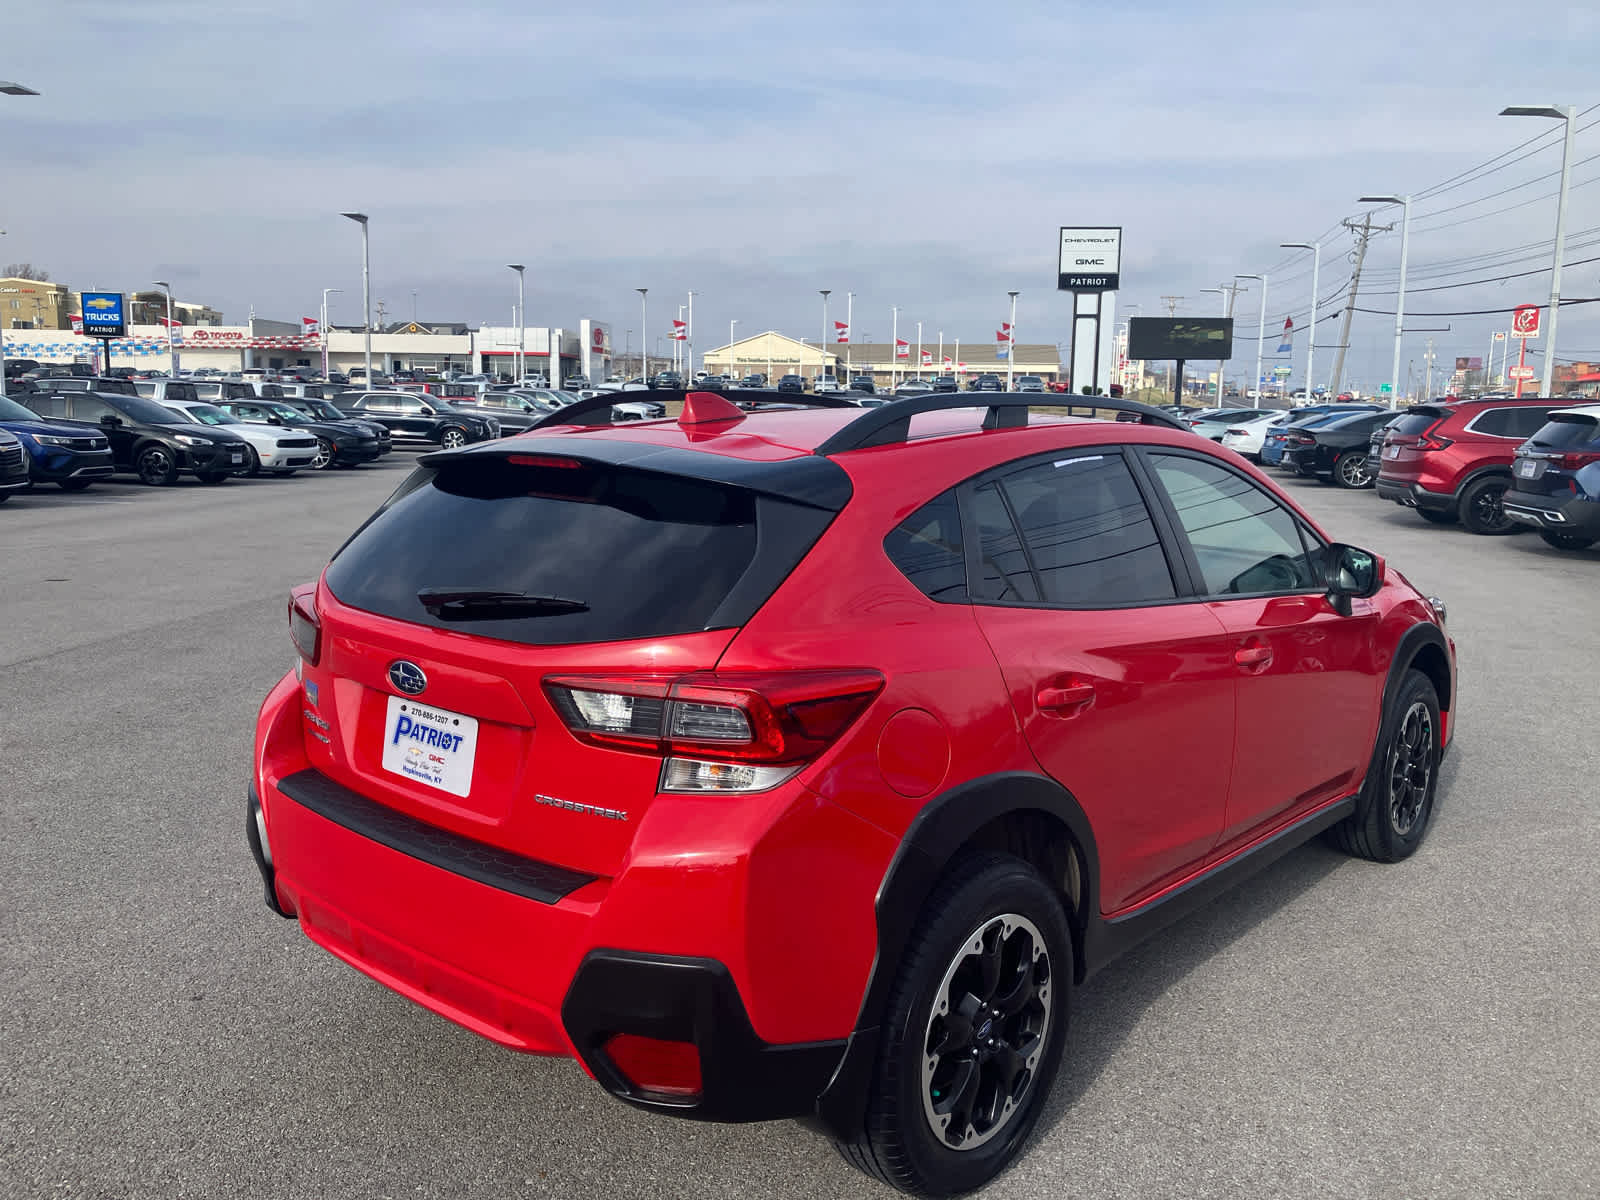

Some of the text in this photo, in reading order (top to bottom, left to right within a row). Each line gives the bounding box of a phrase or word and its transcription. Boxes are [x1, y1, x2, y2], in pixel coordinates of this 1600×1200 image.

[1070, 278, 1107, 286] PATRIOT
[85, 312, 119, 321] TRUCKS
[209, 332, 243, 340] TOYOTA
[428, 753, 445, 765] GMC
[433, 775, 443, 784] KY
[534, 794, 628, 821] CROSSTREK
